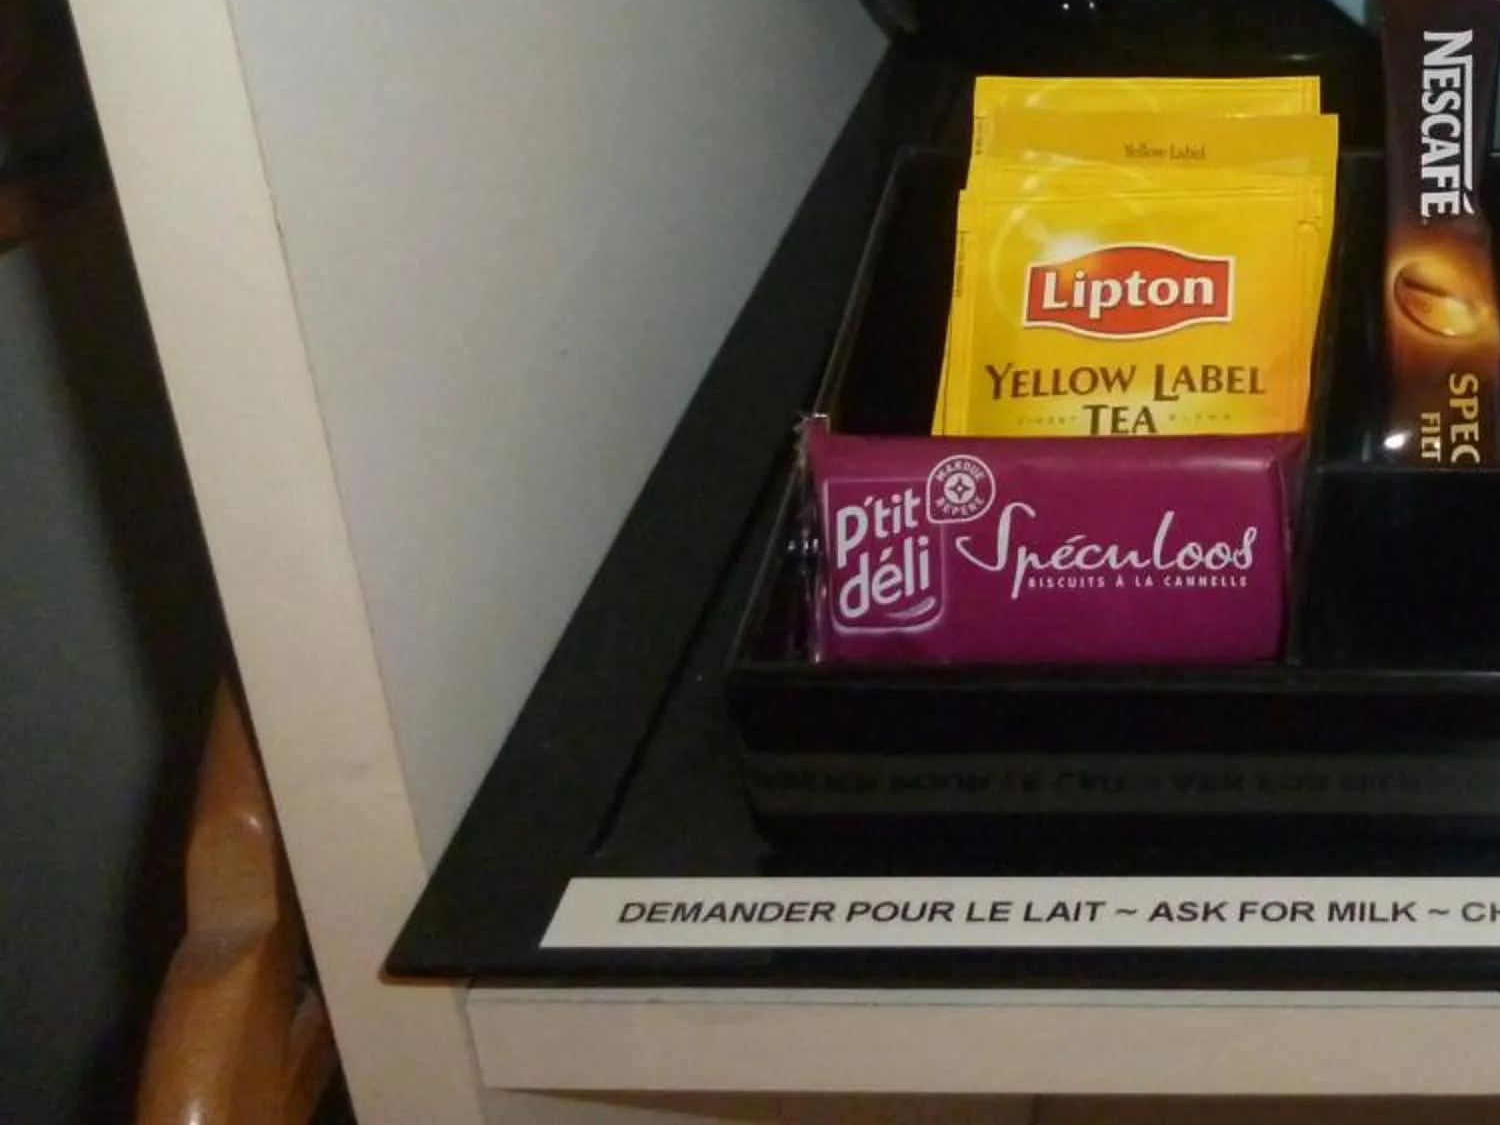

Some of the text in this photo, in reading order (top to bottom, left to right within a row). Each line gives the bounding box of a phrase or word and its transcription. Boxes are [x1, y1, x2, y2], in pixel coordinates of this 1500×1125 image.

[1419, 29, 1476, 219] NESCAFÉ
[1122, 141, 1207, 162] Yellow Label
[1042, 269, 1215, 320] Lipton
[984, 362, 1267, 402] YELLOW LABEL
[1082, 404, 1159, 435] TEA
[1419, 411, 1442, 462] FILT
[1449, 373, 1481, 464] SPEC
[835, 488, 921, 569] P'tit
[954, 501, 1259, 600] Spéculoos
[838, 536, 931, 618] déli
[1027, 575, 1106, 589] BISCUITS
[1134, 574, 1154, 588] LA
[1162, 574, 1249, 589] CANNELLE
[617, 900, 837, 925] DEMANDER
[844, 900, 956, 925] POUR
[964, 900, 1013, 925] LE
[1022, 900, 1107, 925] LAIT
[1147, 900, 1227, 925] ASK
[1237, 900, 1316, 925] FOR
[1326, 900, 1417, 925] MILK
